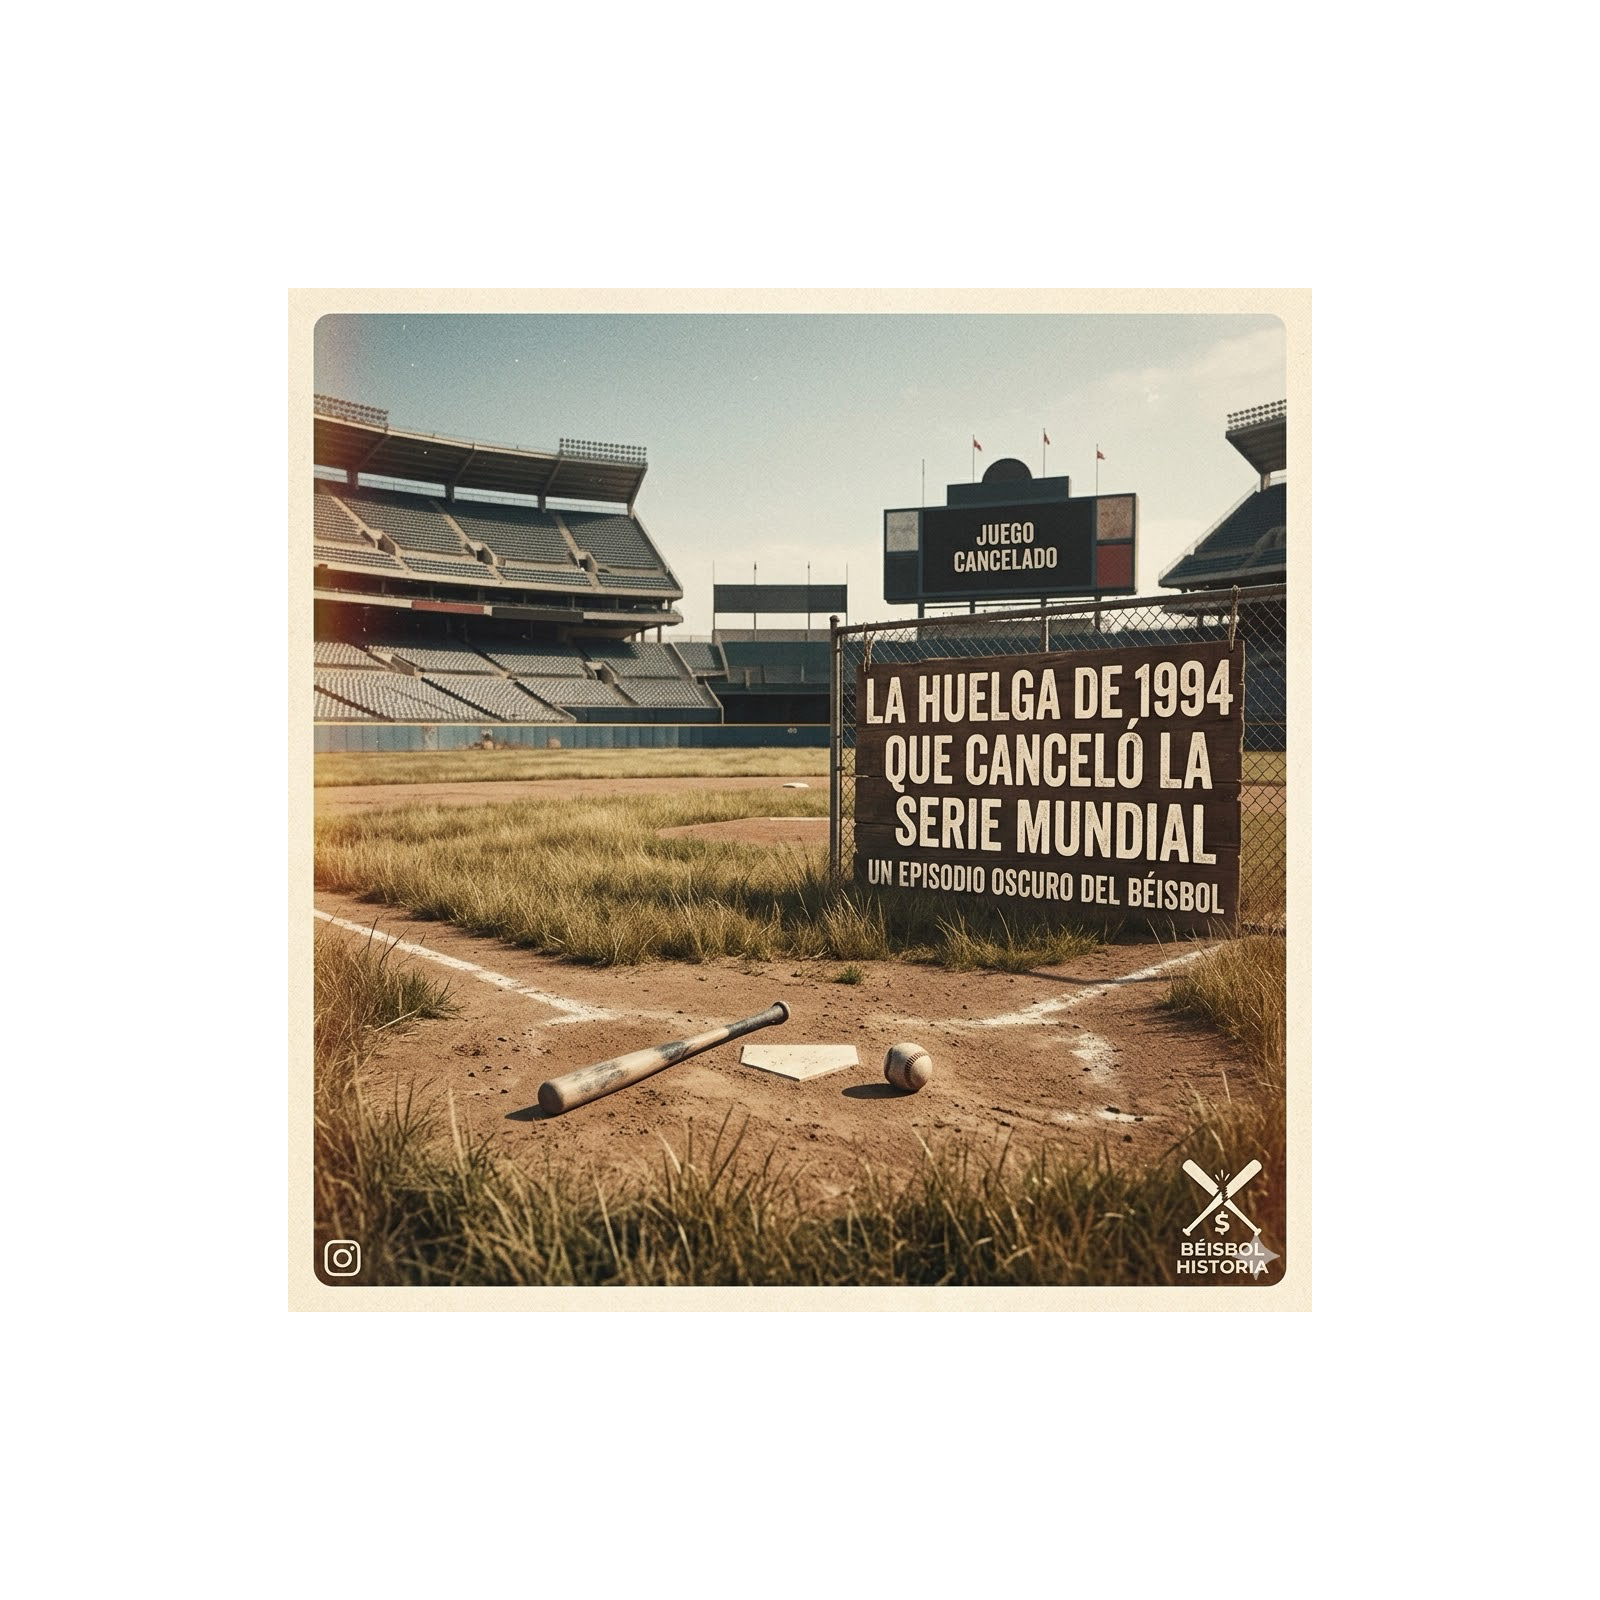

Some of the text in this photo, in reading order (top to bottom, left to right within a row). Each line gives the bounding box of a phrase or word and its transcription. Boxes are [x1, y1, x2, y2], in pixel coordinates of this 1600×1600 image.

[953, 546, 1058, 573] CANCELADO
[976, 521, 1034, 546] JUEGO
[866, 659, 1234, 724] LA HUELGA DE 1994
[884, 718, 1213, 793] QUE CANCELÓ LA
[895, 795, 1217, 865] SERIE MUNDIAL
[868, 859, 1225, 915] UN EPISODIO OSCURO DEL BÉISBOL
